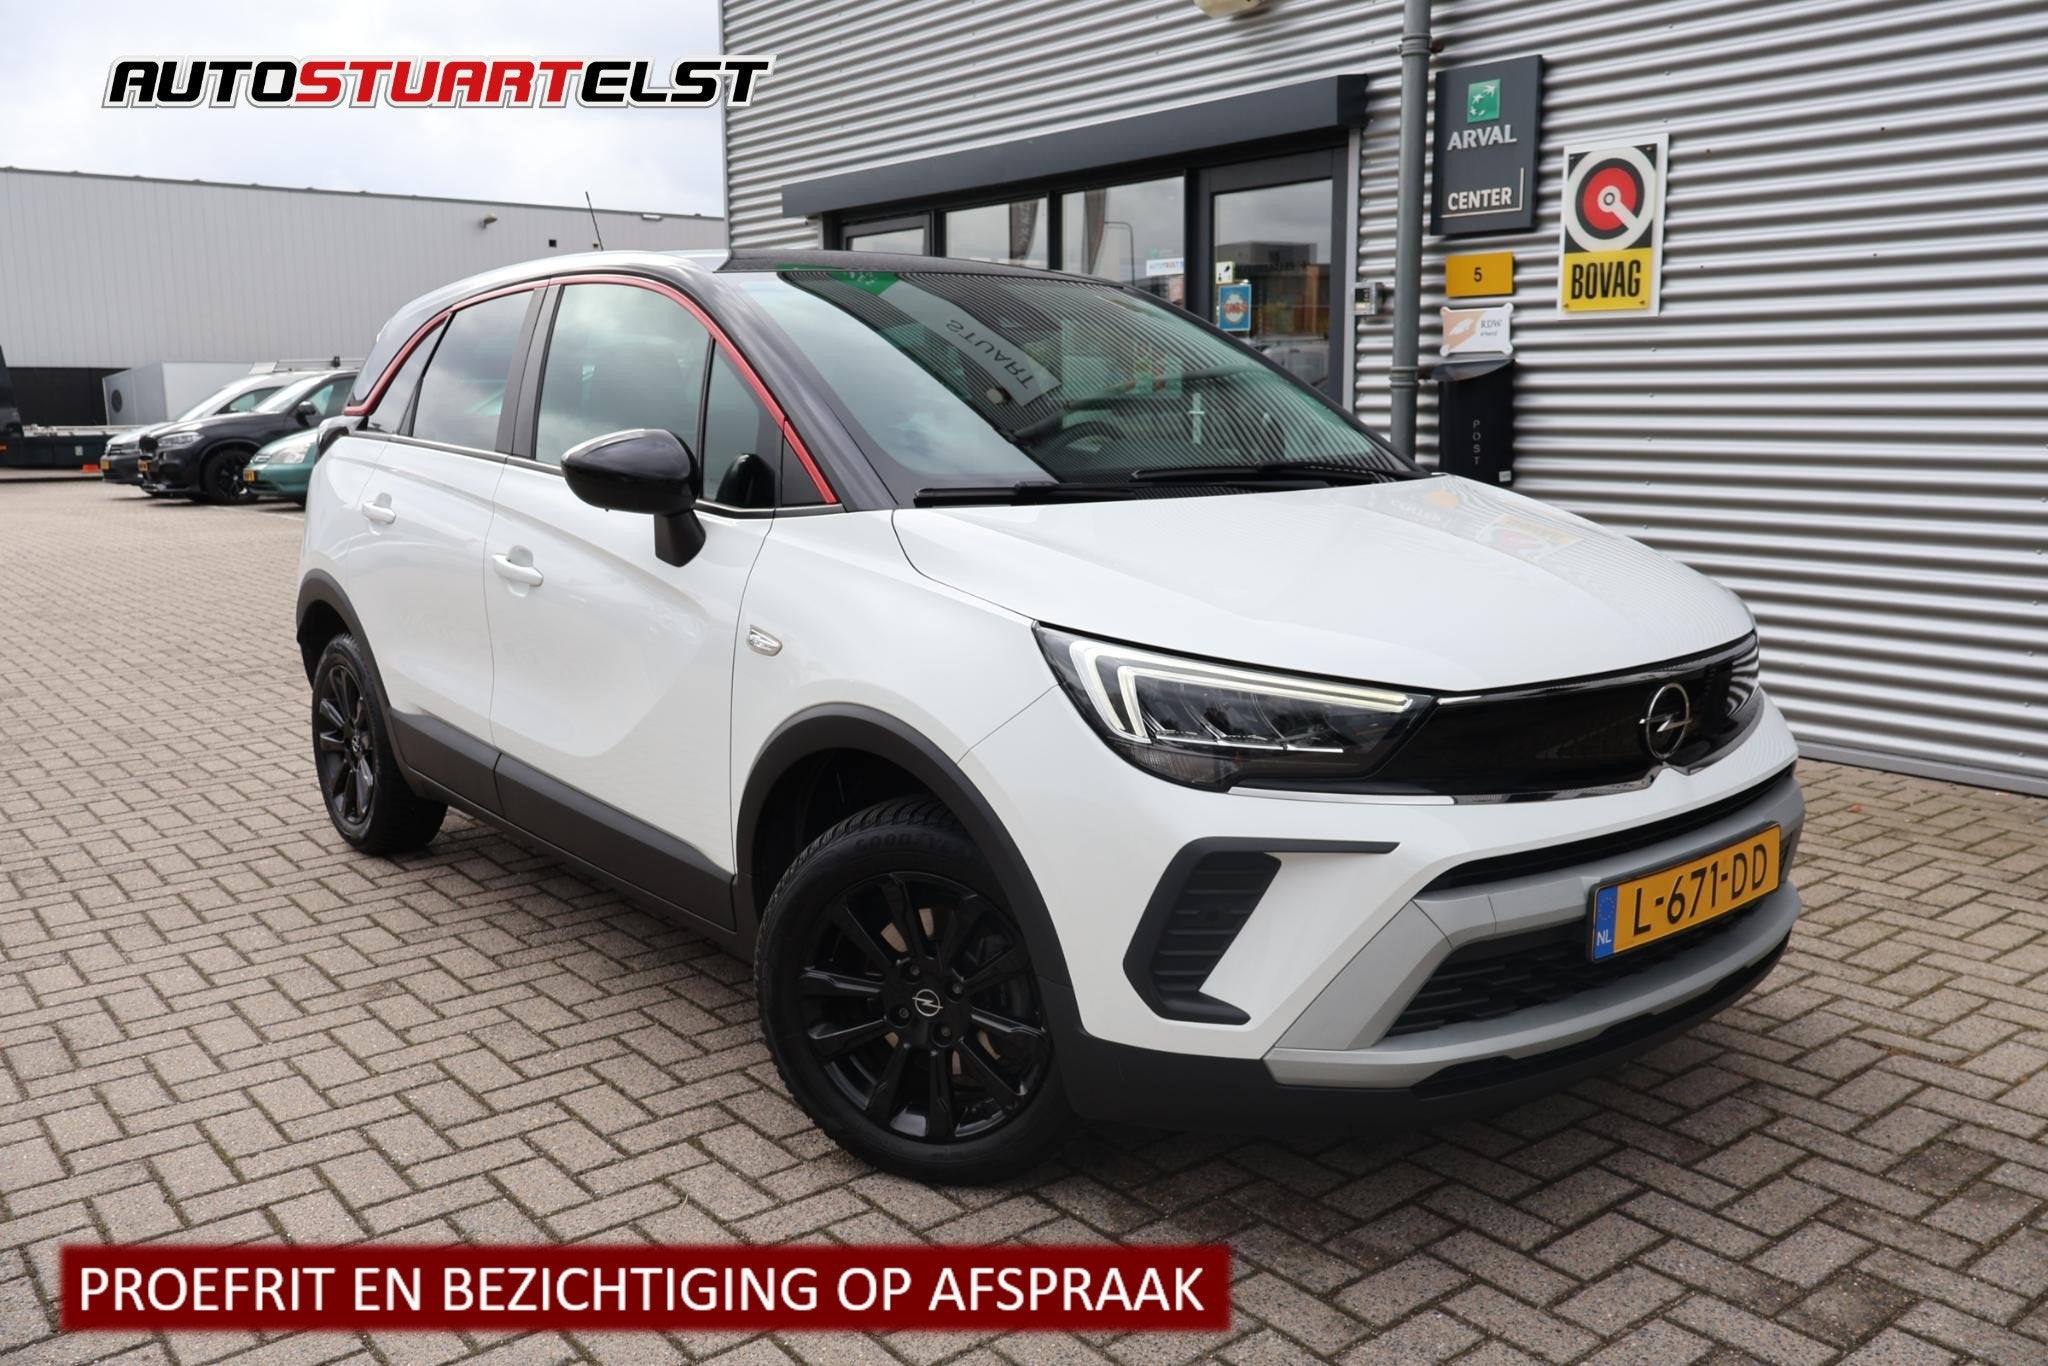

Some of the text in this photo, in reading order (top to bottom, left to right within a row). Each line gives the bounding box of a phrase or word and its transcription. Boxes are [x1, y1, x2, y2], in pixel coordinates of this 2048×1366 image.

[1447, 124, 1518, 150] ARVAL
[1447, 187, 1512, 211] CENTER
[1473, 266, 1483, 282] 5
[1571, 259, 1641, 299] BOVAG
[1480, 319, 1503, 329] RDW
[1472, 419, 1481, 465] POST
[1633, 844, 1767, 936] L-671-DD
[1596, 929, 1612, 946] NL
